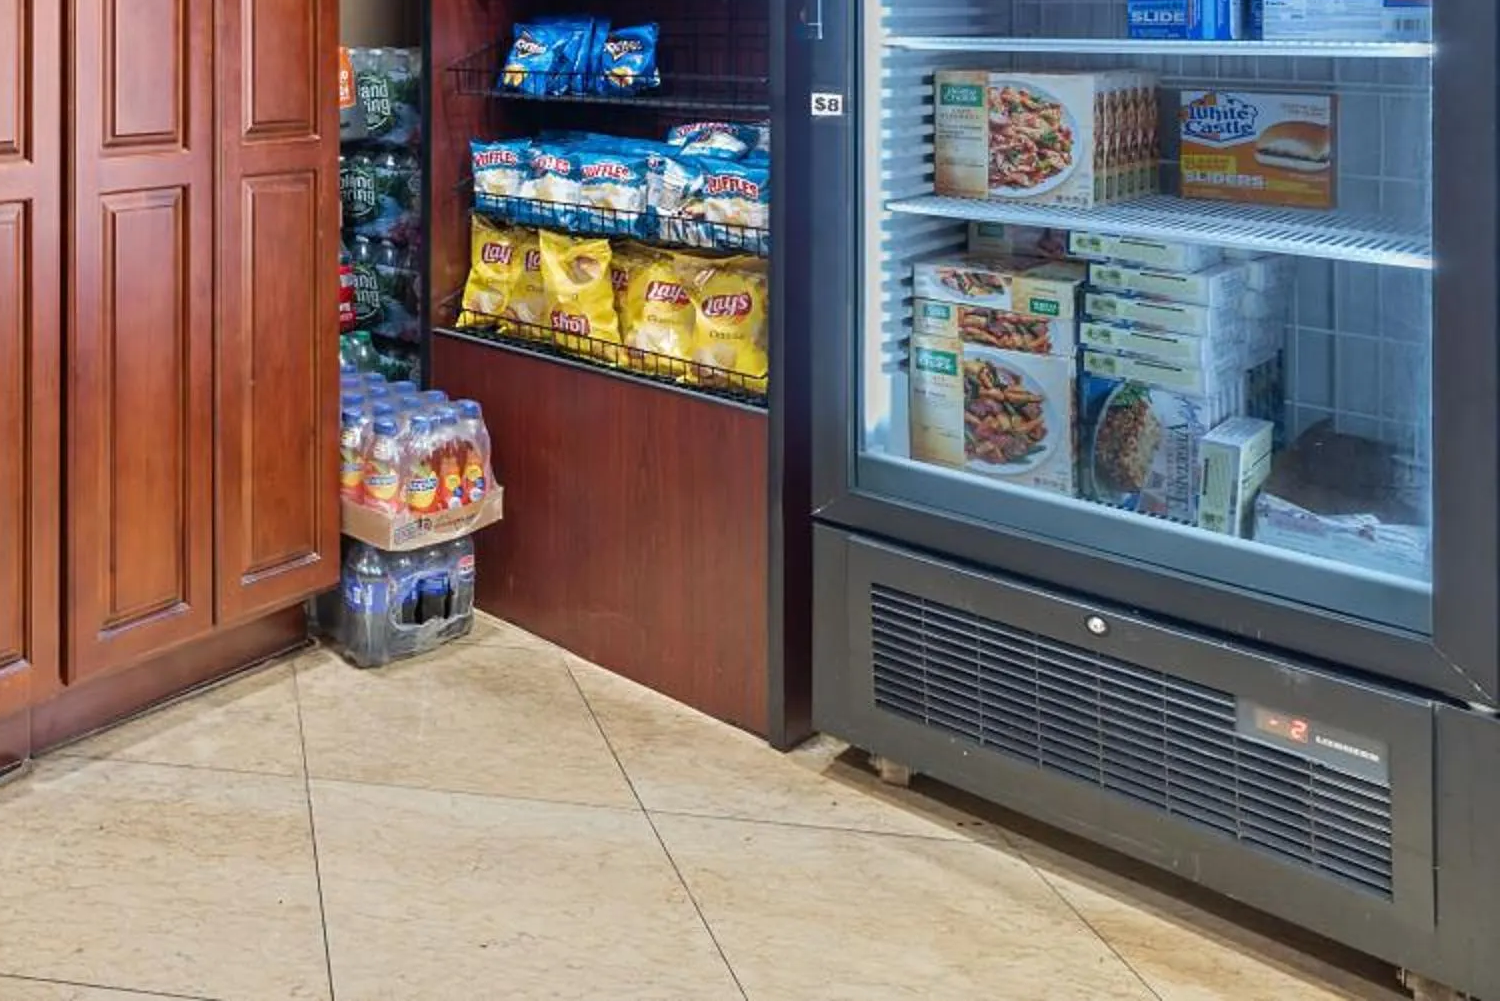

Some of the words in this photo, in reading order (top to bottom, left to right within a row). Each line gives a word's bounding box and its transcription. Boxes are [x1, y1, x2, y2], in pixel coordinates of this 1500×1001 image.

[814, 96, 839, 112] $8
[1188, 103, 1250, 123] White
[1185, 119, 1253, 137] Castle
[704, 175, 759, 199] RUFFLES
